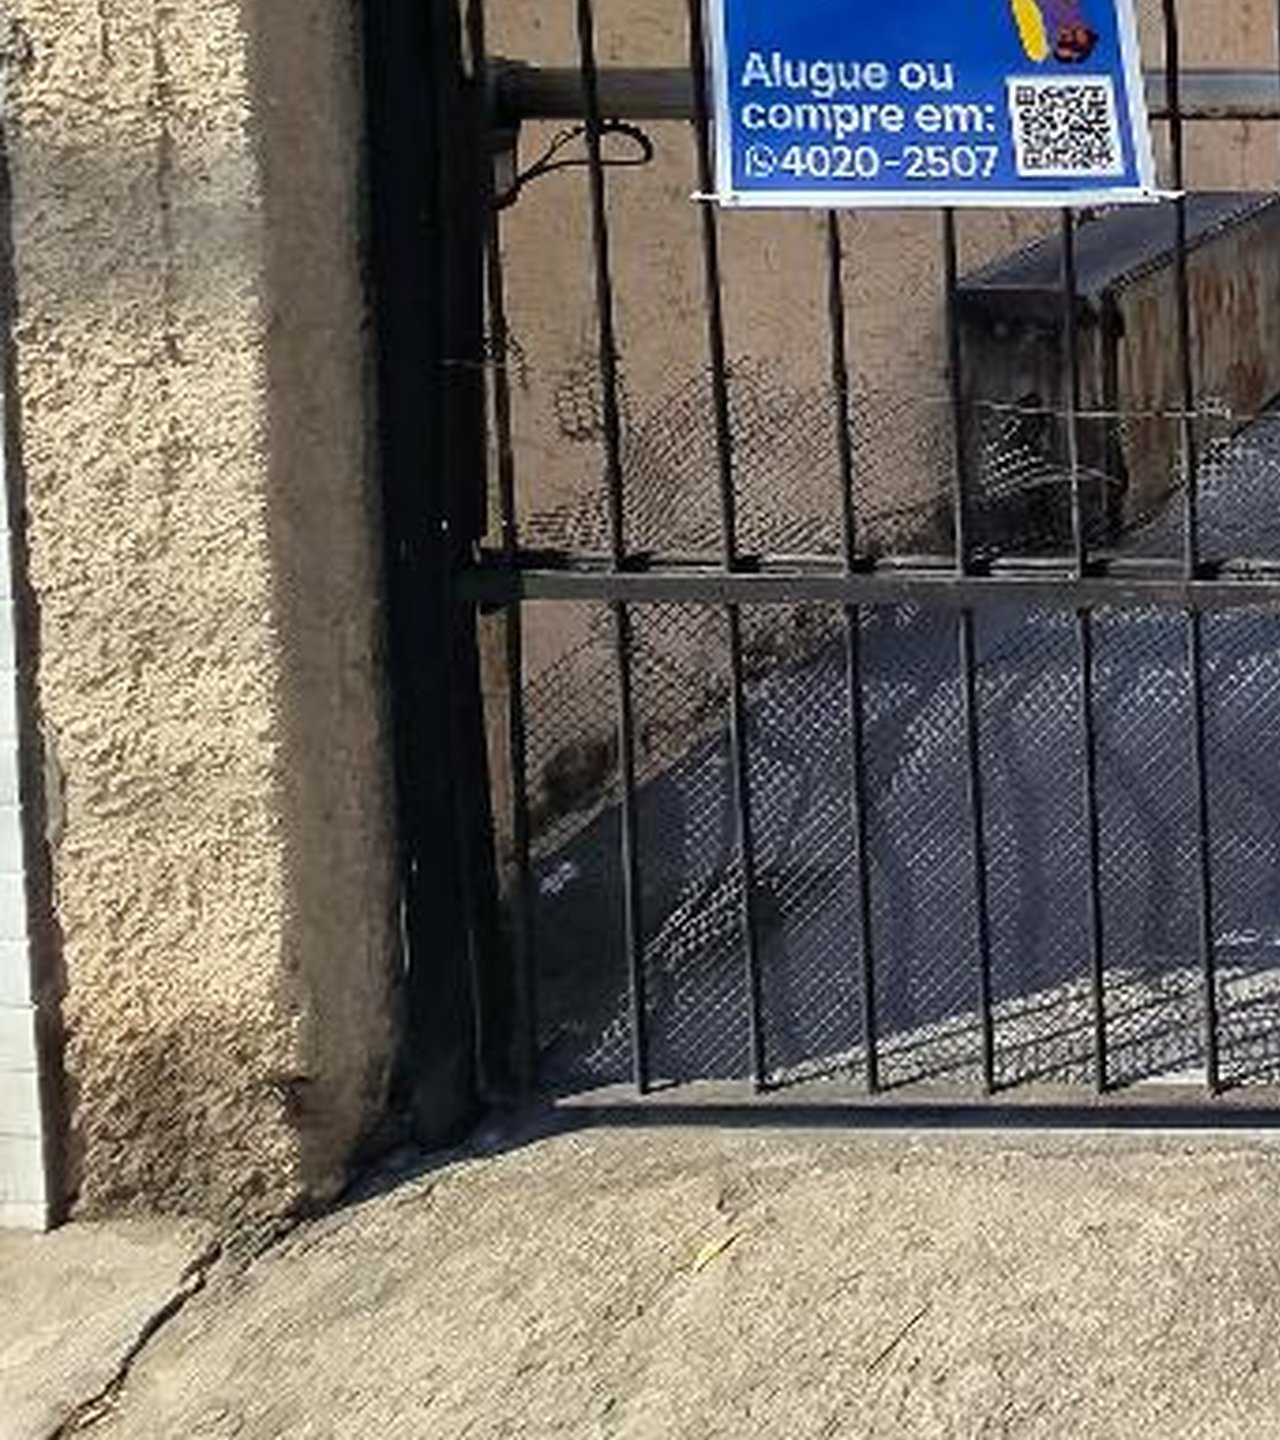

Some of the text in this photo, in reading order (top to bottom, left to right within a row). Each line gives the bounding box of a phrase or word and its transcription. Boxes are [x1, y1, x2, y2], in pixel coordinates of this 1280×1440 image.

[741, 52, 954, 98] Alugue ou
[741, 102, 996, 139] compre em:
[781, 144, 999, 178] 4020-2507
